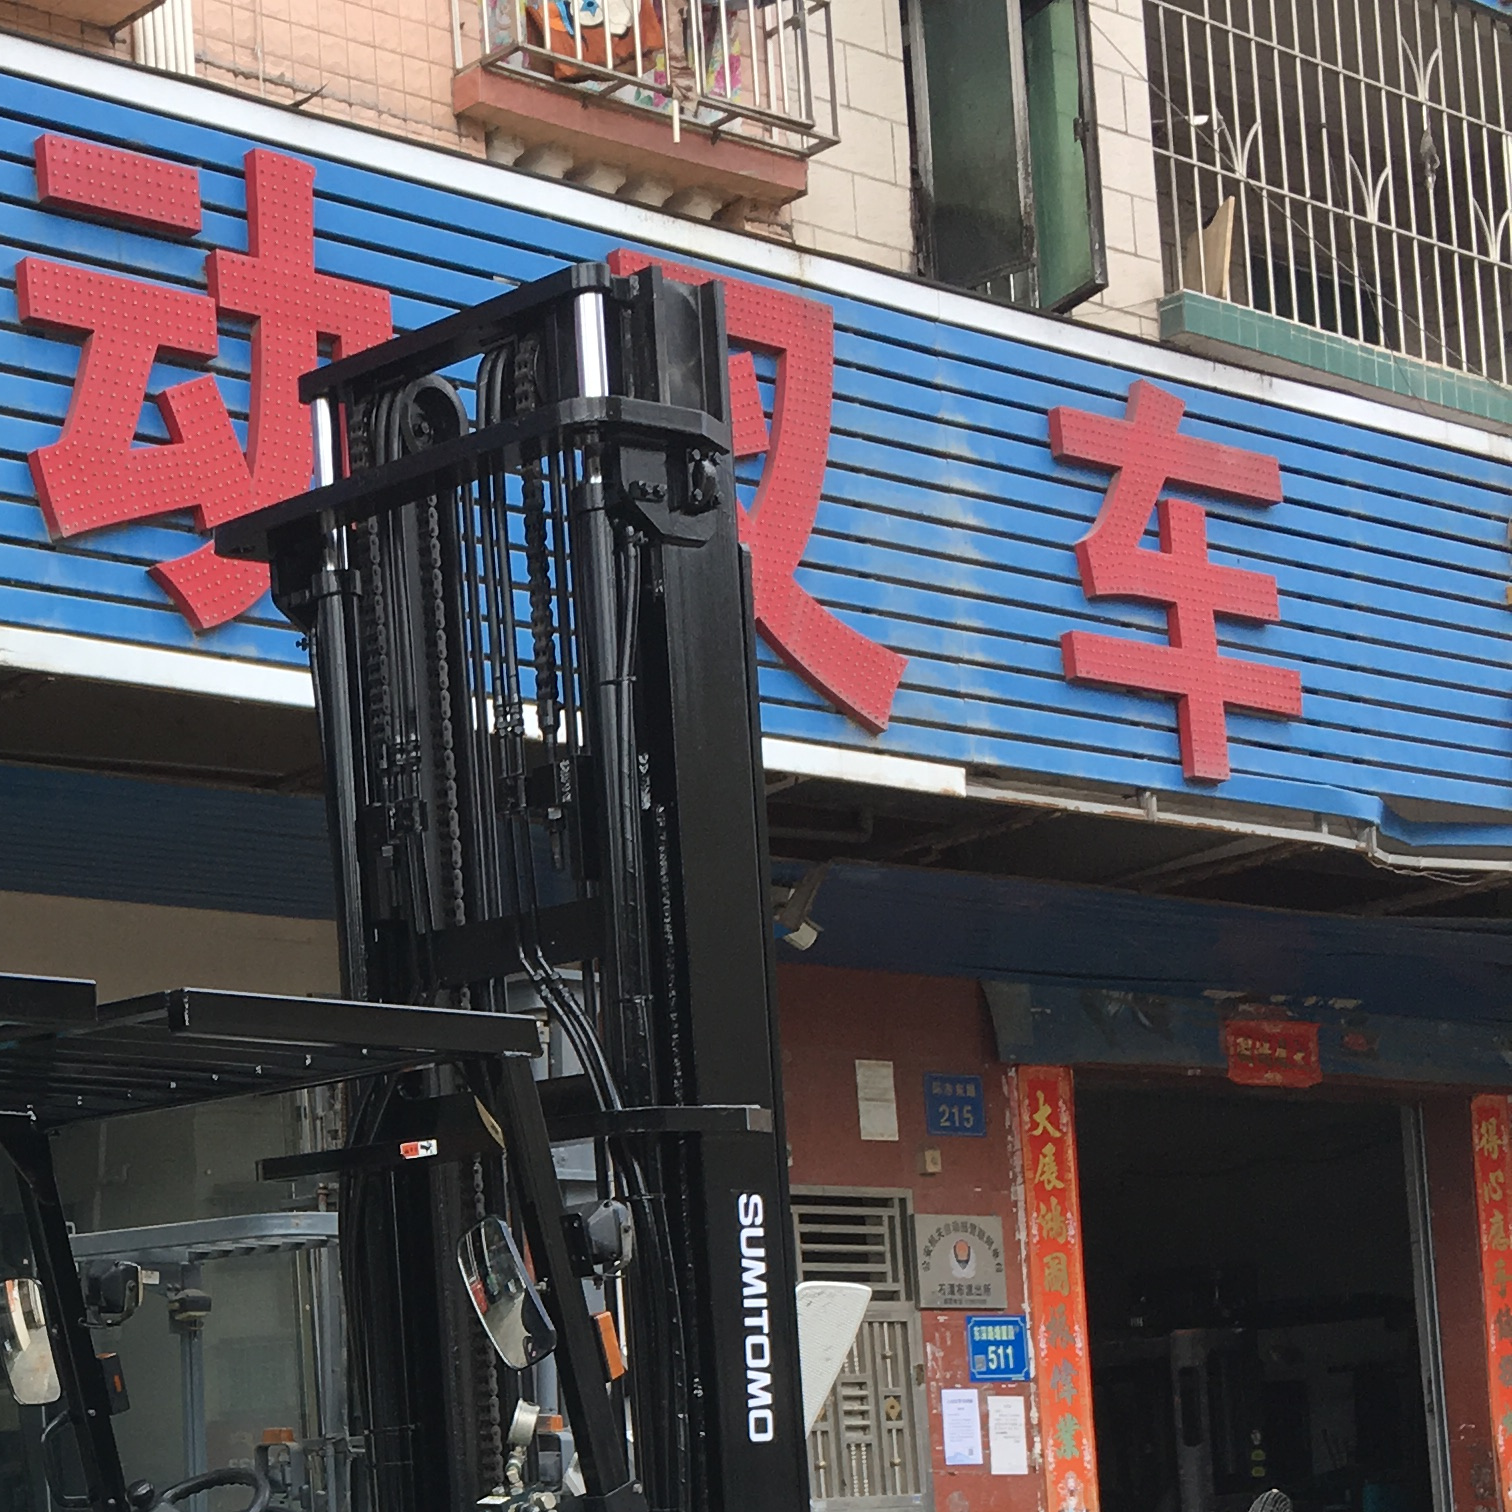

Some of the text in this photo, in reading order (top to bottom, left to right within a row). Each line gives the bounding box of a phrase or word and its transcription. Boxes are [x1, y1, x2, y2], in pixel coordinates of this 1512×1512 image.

[938, 1104, 974, 1128] 215
[738, 1193, 774, 1443] SUMITOMO
[988, 1345, 1014, 1369] 511
